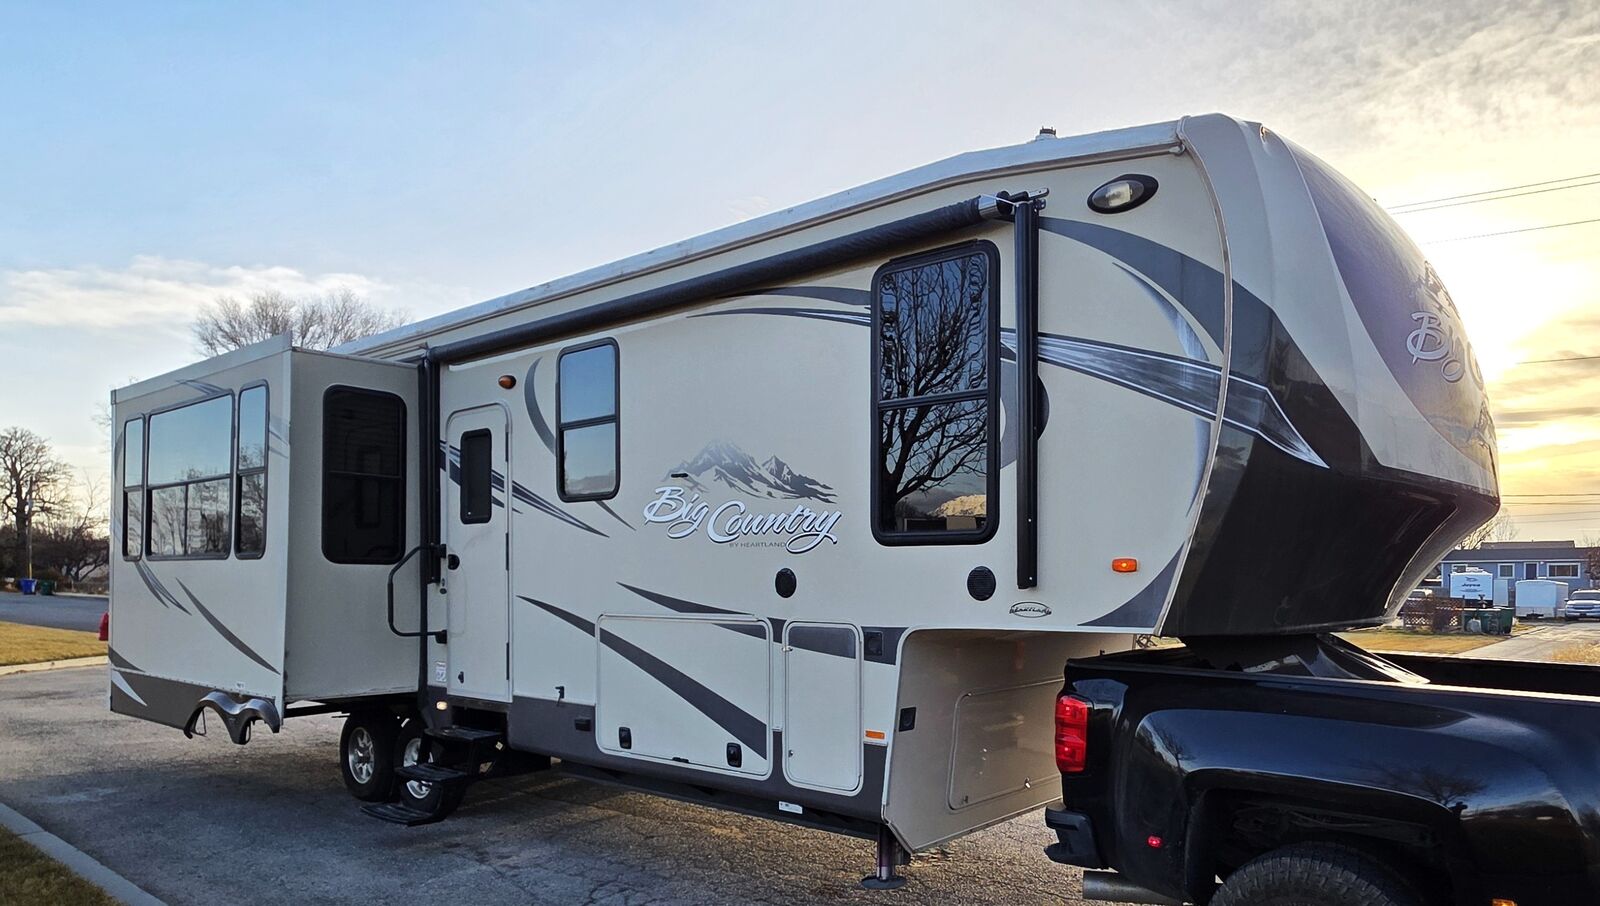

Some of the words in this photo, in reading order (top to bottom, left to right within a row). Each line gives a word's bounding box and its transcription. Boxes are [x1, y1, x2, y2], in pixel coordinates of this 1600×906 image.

[643, 486, 709, 539] Big
[707, 500, 842, 554] Country
[740, 541, 786, 549] HEARTLAND
